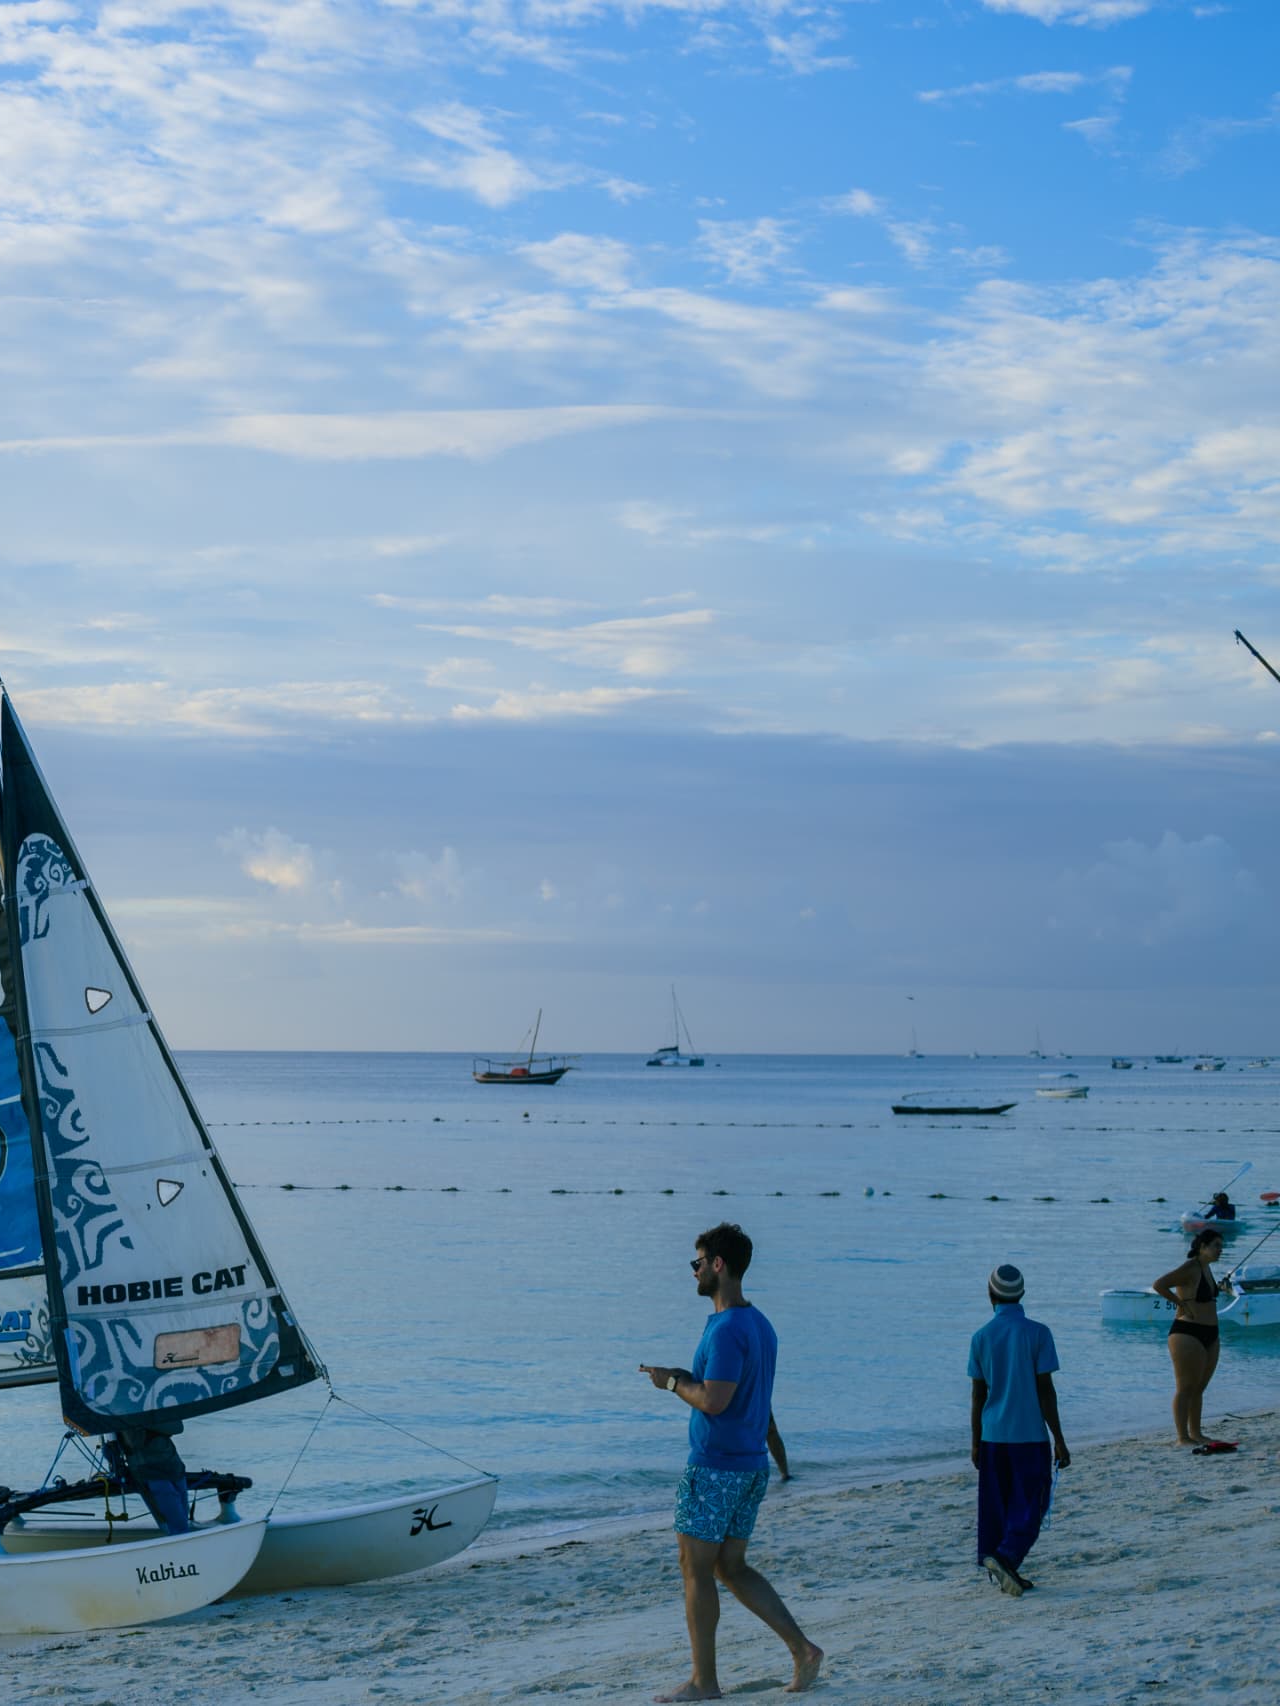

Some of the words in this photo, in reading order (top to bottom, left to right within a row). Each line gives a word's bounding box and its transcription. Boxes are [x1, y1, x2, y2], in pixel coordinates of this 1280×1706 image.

[77, 1278, 184, 1306] HOBIE
[191, 1264, 247, 1296] CAT
[136, 1561, 200, 1584] Kabisa
